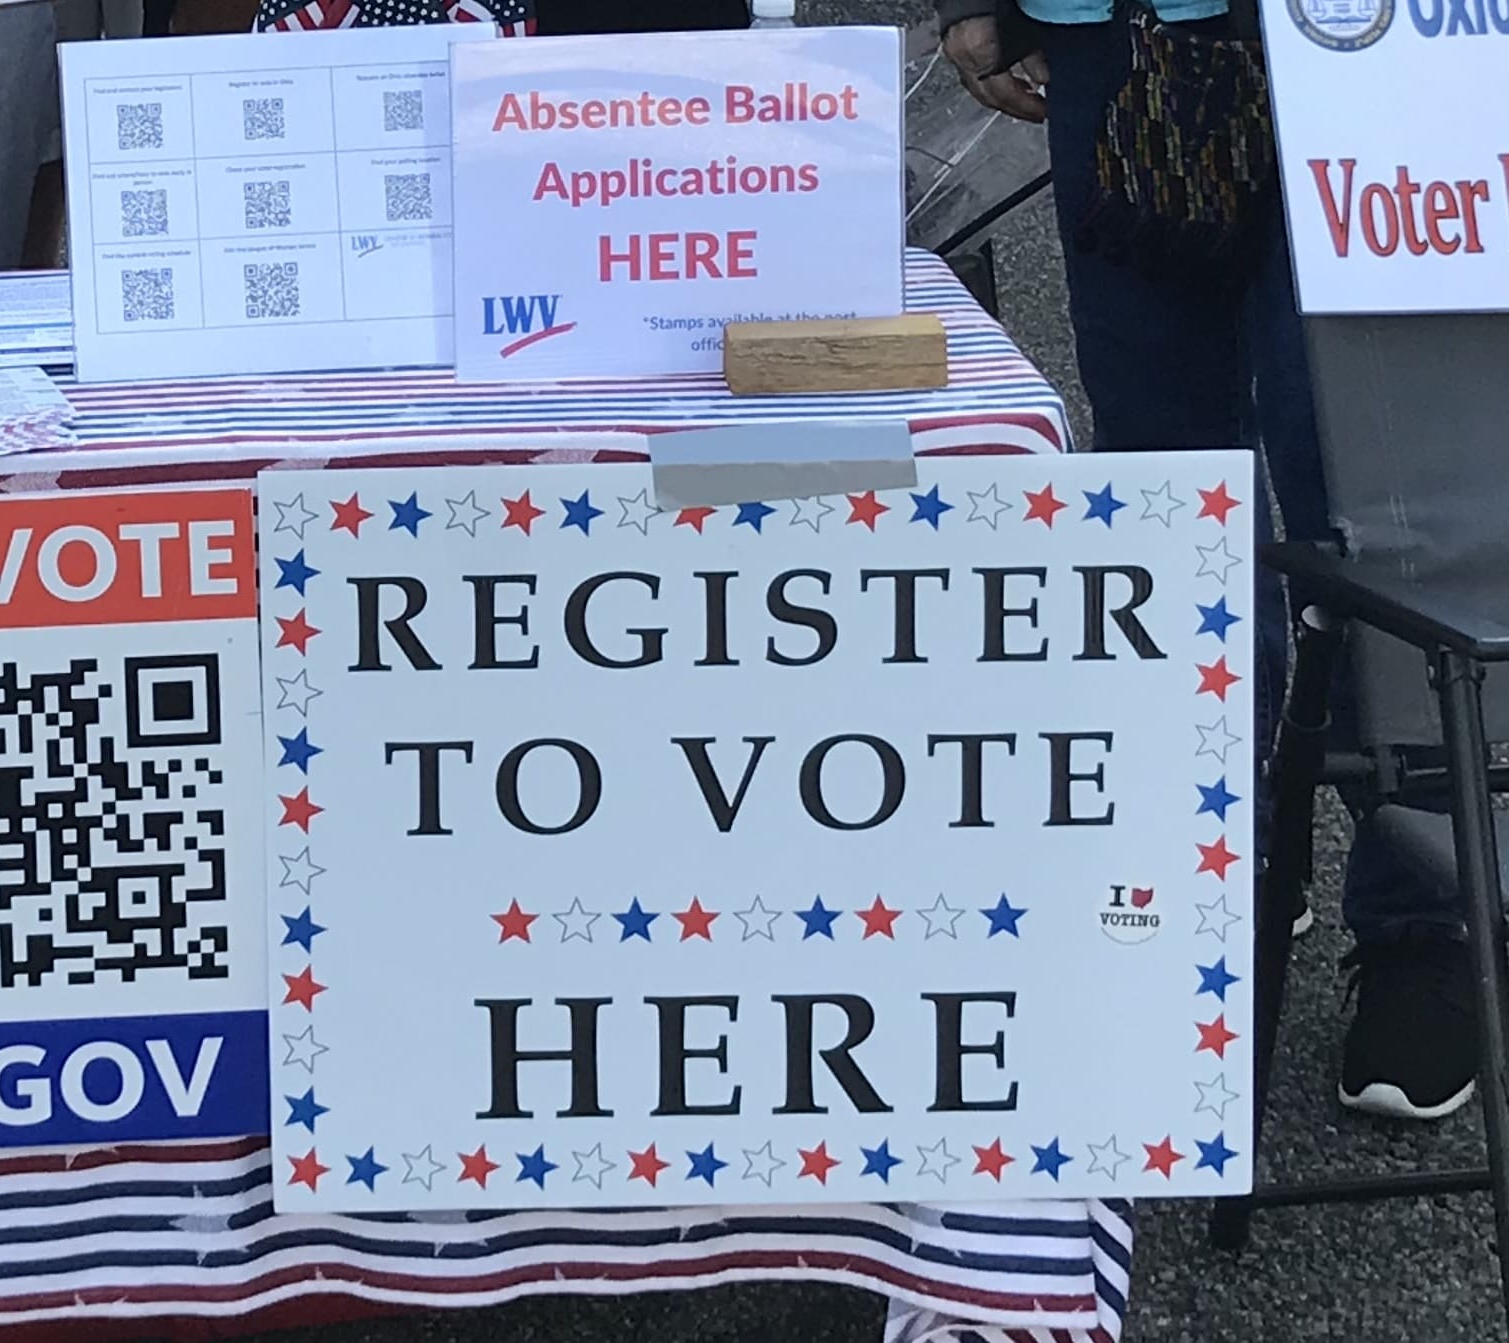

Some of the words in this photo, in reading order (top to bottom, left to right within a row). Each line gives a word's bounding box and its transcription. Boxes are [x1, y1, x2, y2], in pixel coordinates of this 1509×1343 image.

[494, 92, 710, 132] Absentee
[725, 83, 859, 124] Ballot
[534, 157, 819, 207] Applications
[1306, 158, 1490, 258] Voter
[599, 230, 759, 282] HERE
[481, 294, 560, 336] LWV
[690, 336, 725, 352] offic
[346, 565, 1168, 673] REGISTER
[384, 738, 603, 836] TO
[670, 731, 1115, 833] VOTE
[1099, 911, 1161, 928] VOTING
[1109, 884, 1126, 907] I
[473, 991, 1019, 1120] HERE
